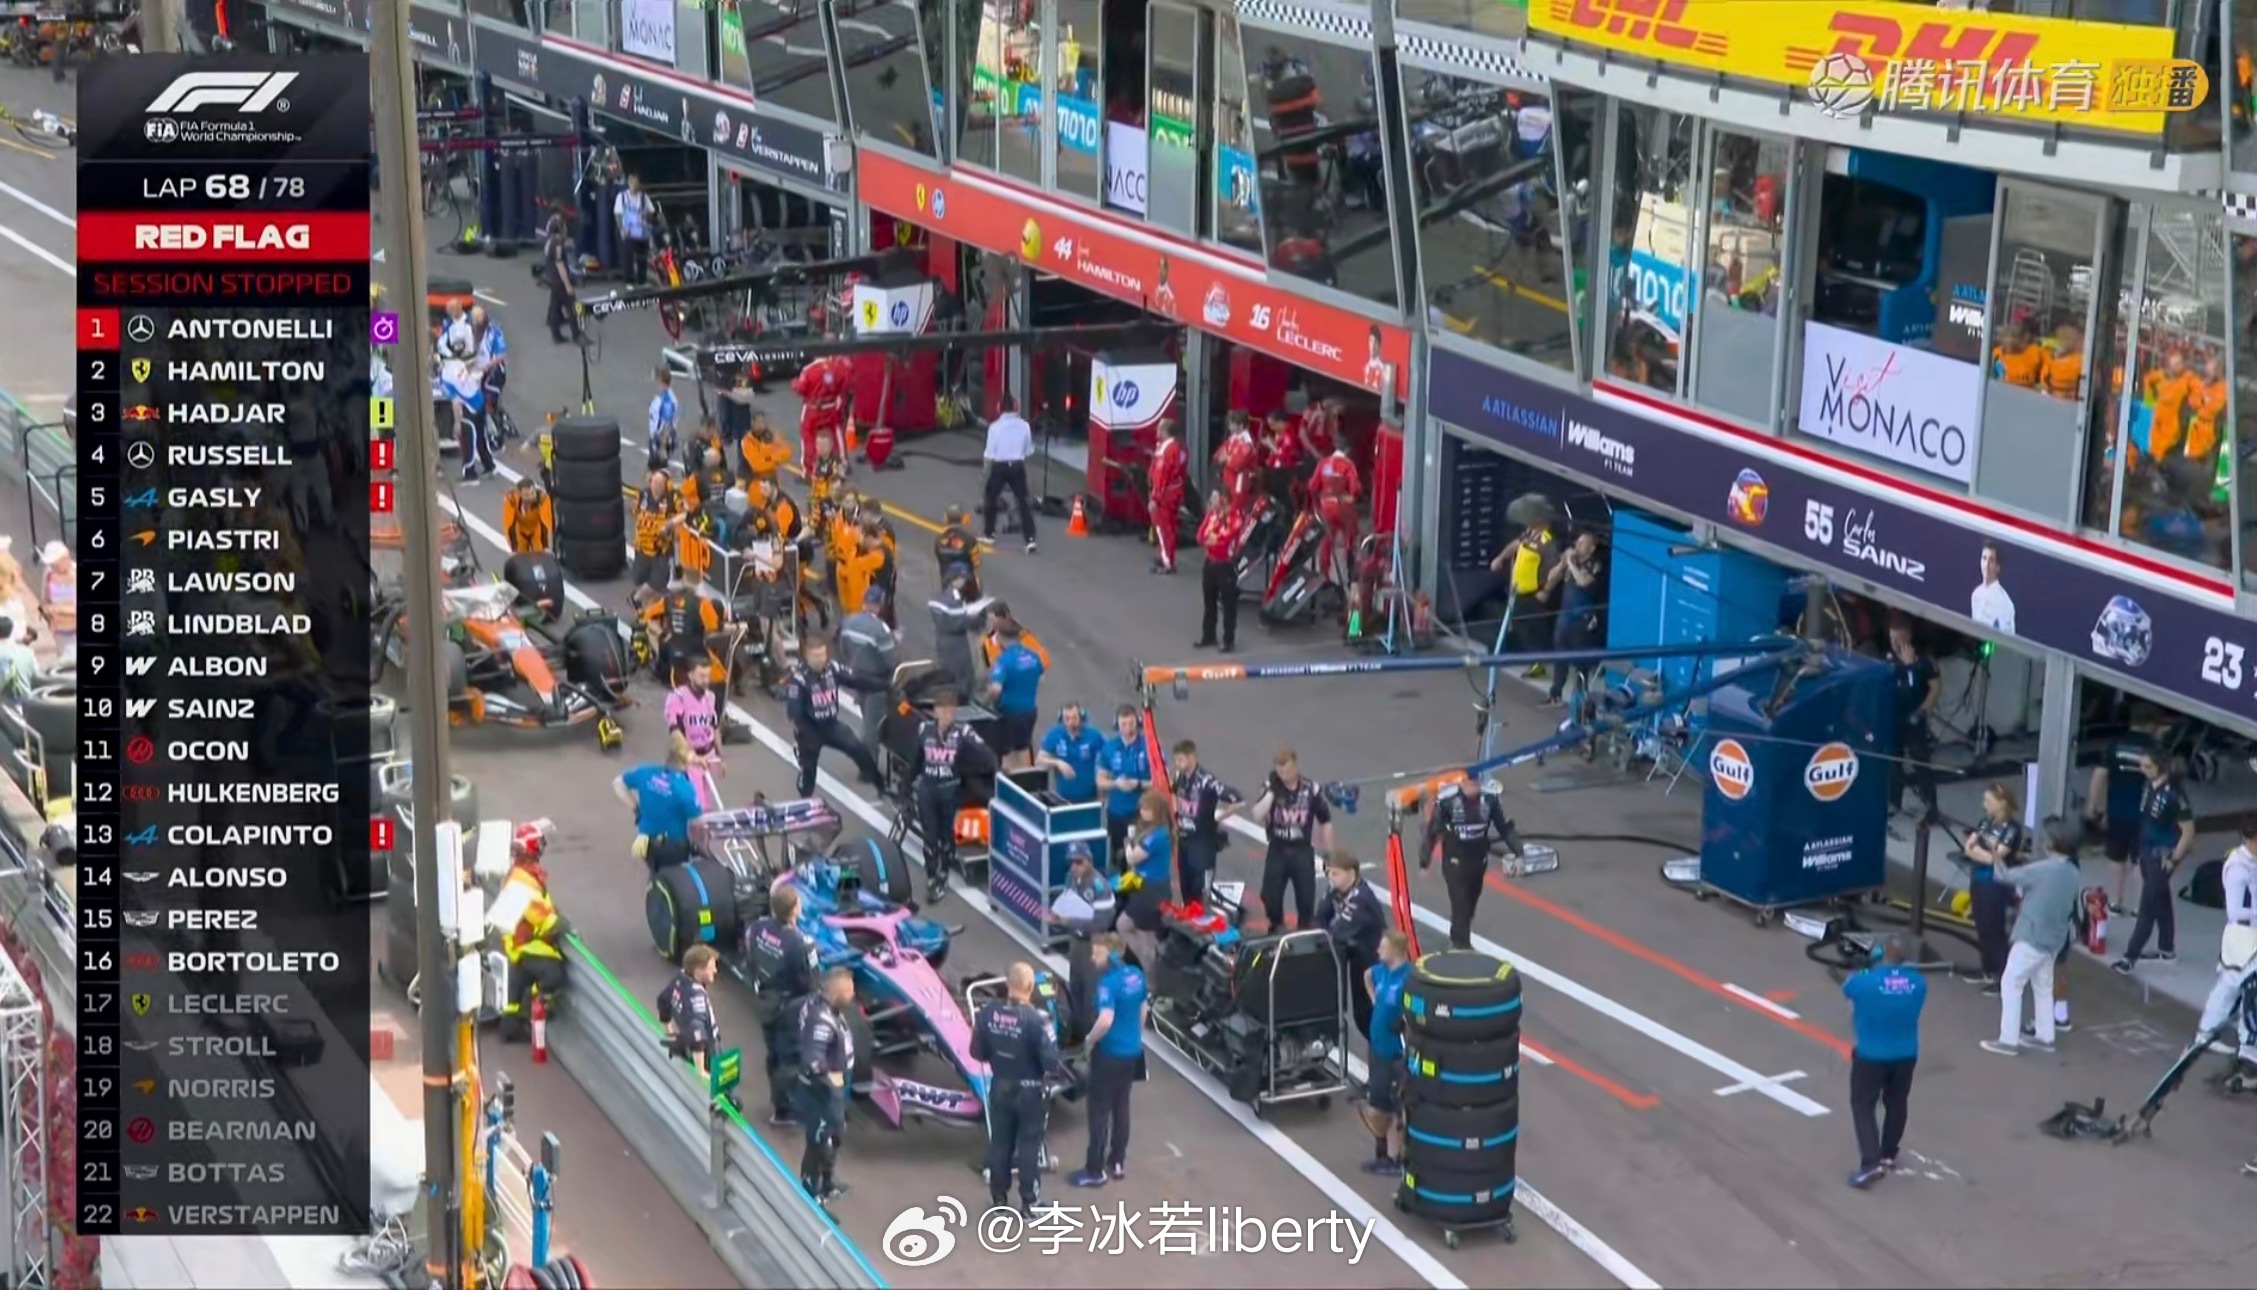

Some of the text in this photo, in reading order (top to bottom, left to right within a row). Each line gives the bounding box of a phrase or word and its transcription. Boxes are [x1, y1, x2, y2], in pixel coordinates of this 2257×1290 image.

[752, 141, 819, 173] VERSTAPPEN
[1053, 237, 1072, 261] 44
[1077, 259, 1142, 292] HAMILTON
[1250, 303, 1271, 331] 16
[1277, 325, 1343, 362] LECLERC
[1826, 350, 1902, 405] Visit
[1492, 399, 1558, 438] ATLASSIAN
[1820, 385, 1965, 466] MONACO
[1568, 419, 1635, 464] Williams
[1614, 462, 1633, 477] TEAM
[1804, 499, 1833, 546] 55
[1843, 508, 1877, 543] Carlos
[1843, 538, 1925, 583] SAINZ
[2201, 636, 2245, 690] 23
[1713, 755, 1750, 782] Gulf
[1808, 760, 1855, 783] Gulf
[1803, 850, 1852, 868] Williams
